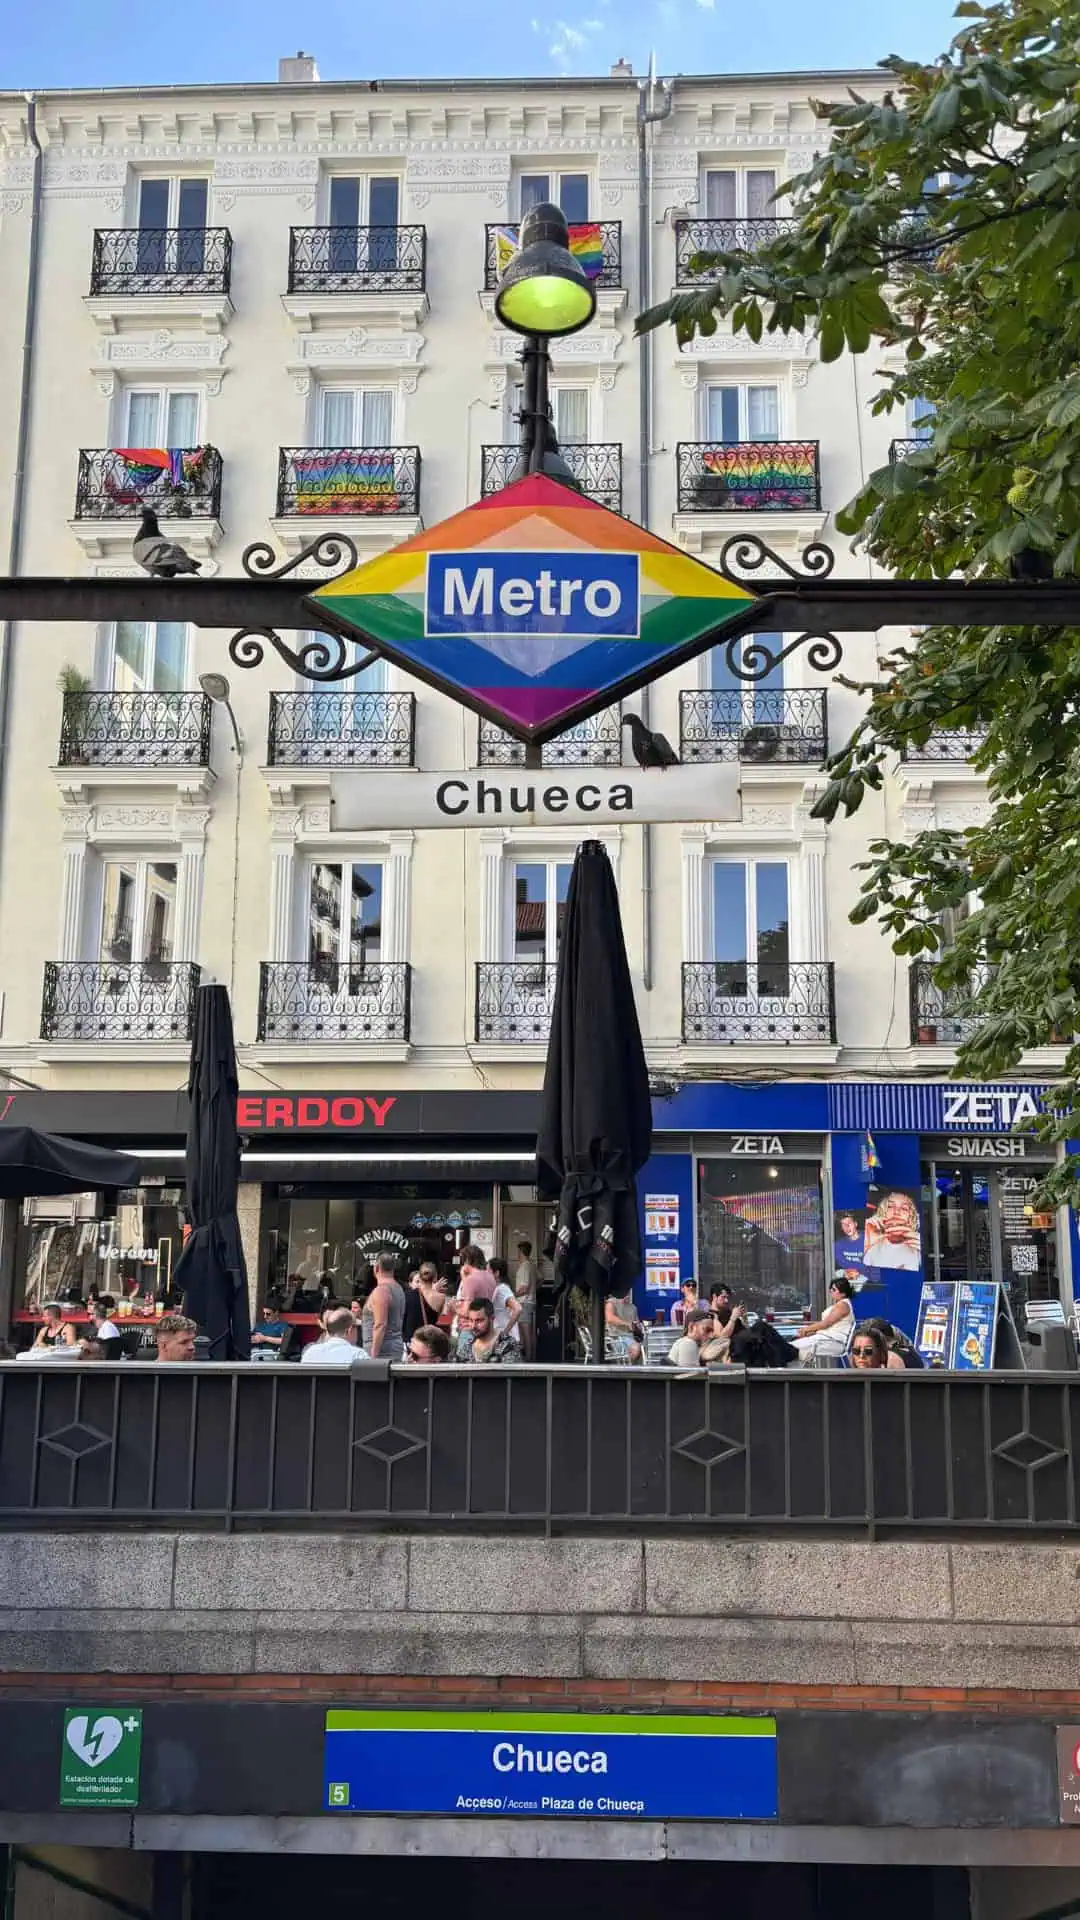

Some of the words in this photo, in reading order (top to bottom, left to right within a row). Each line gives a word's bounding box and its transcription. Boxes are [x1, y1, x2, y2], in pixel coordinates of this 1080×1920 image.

[443, 567, 622, 618] Metro
[436, 780, 634, 816] Chueca
[236, 1097, 397, 1128] ERDOY
[943, 1092, 1038, 1124] ZETA
[731, 1136, 784, 1155] ZETA
[947, 1137, 1026, 1158] SMASH
[1001, 1177, 1039, 1191] ZETA
[355, 1229, 409, 1250] BENDITO
[99, 1245, 158, 1264] Verdoy
[492, 1742, 608, 1773] Chueca
[125, 1776, 134, 1784] de
[334, 1786, 345, 1802] 5
[541, 1797, 575, 1810] Plaza
[578, 1798, 594, 1811] de
[597, 1798, 645, 1811] Chueca
